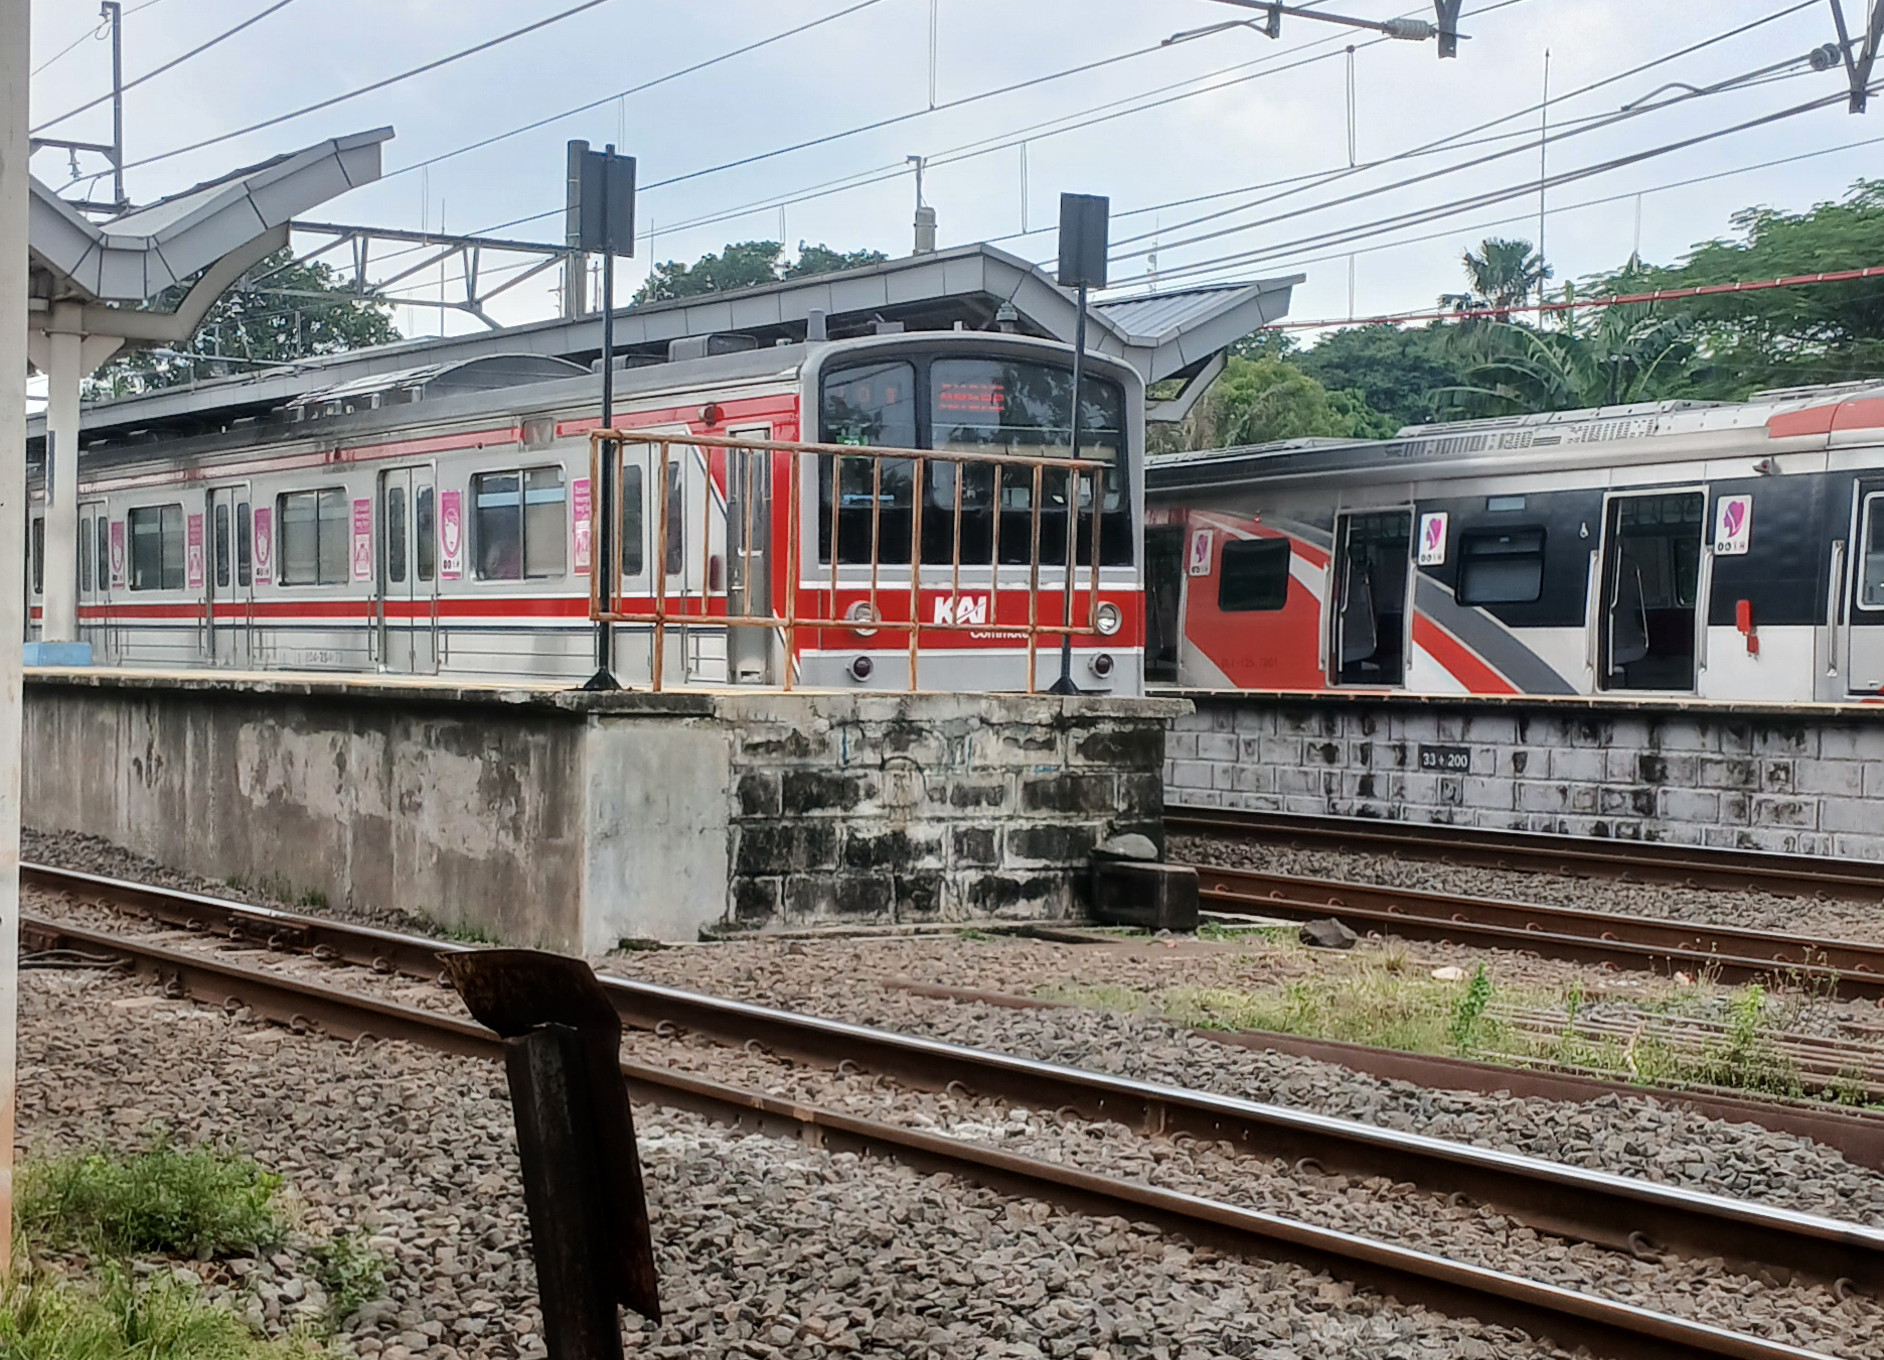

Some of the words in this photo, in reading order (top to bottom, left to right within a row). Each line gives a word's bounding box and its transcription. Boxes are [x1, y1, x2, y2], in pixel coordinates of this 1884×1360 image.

[934, 596, 987, 625] KAI
[1423, 752, 1436, 766] 33
[1447, 753, 1468, 768] 200
